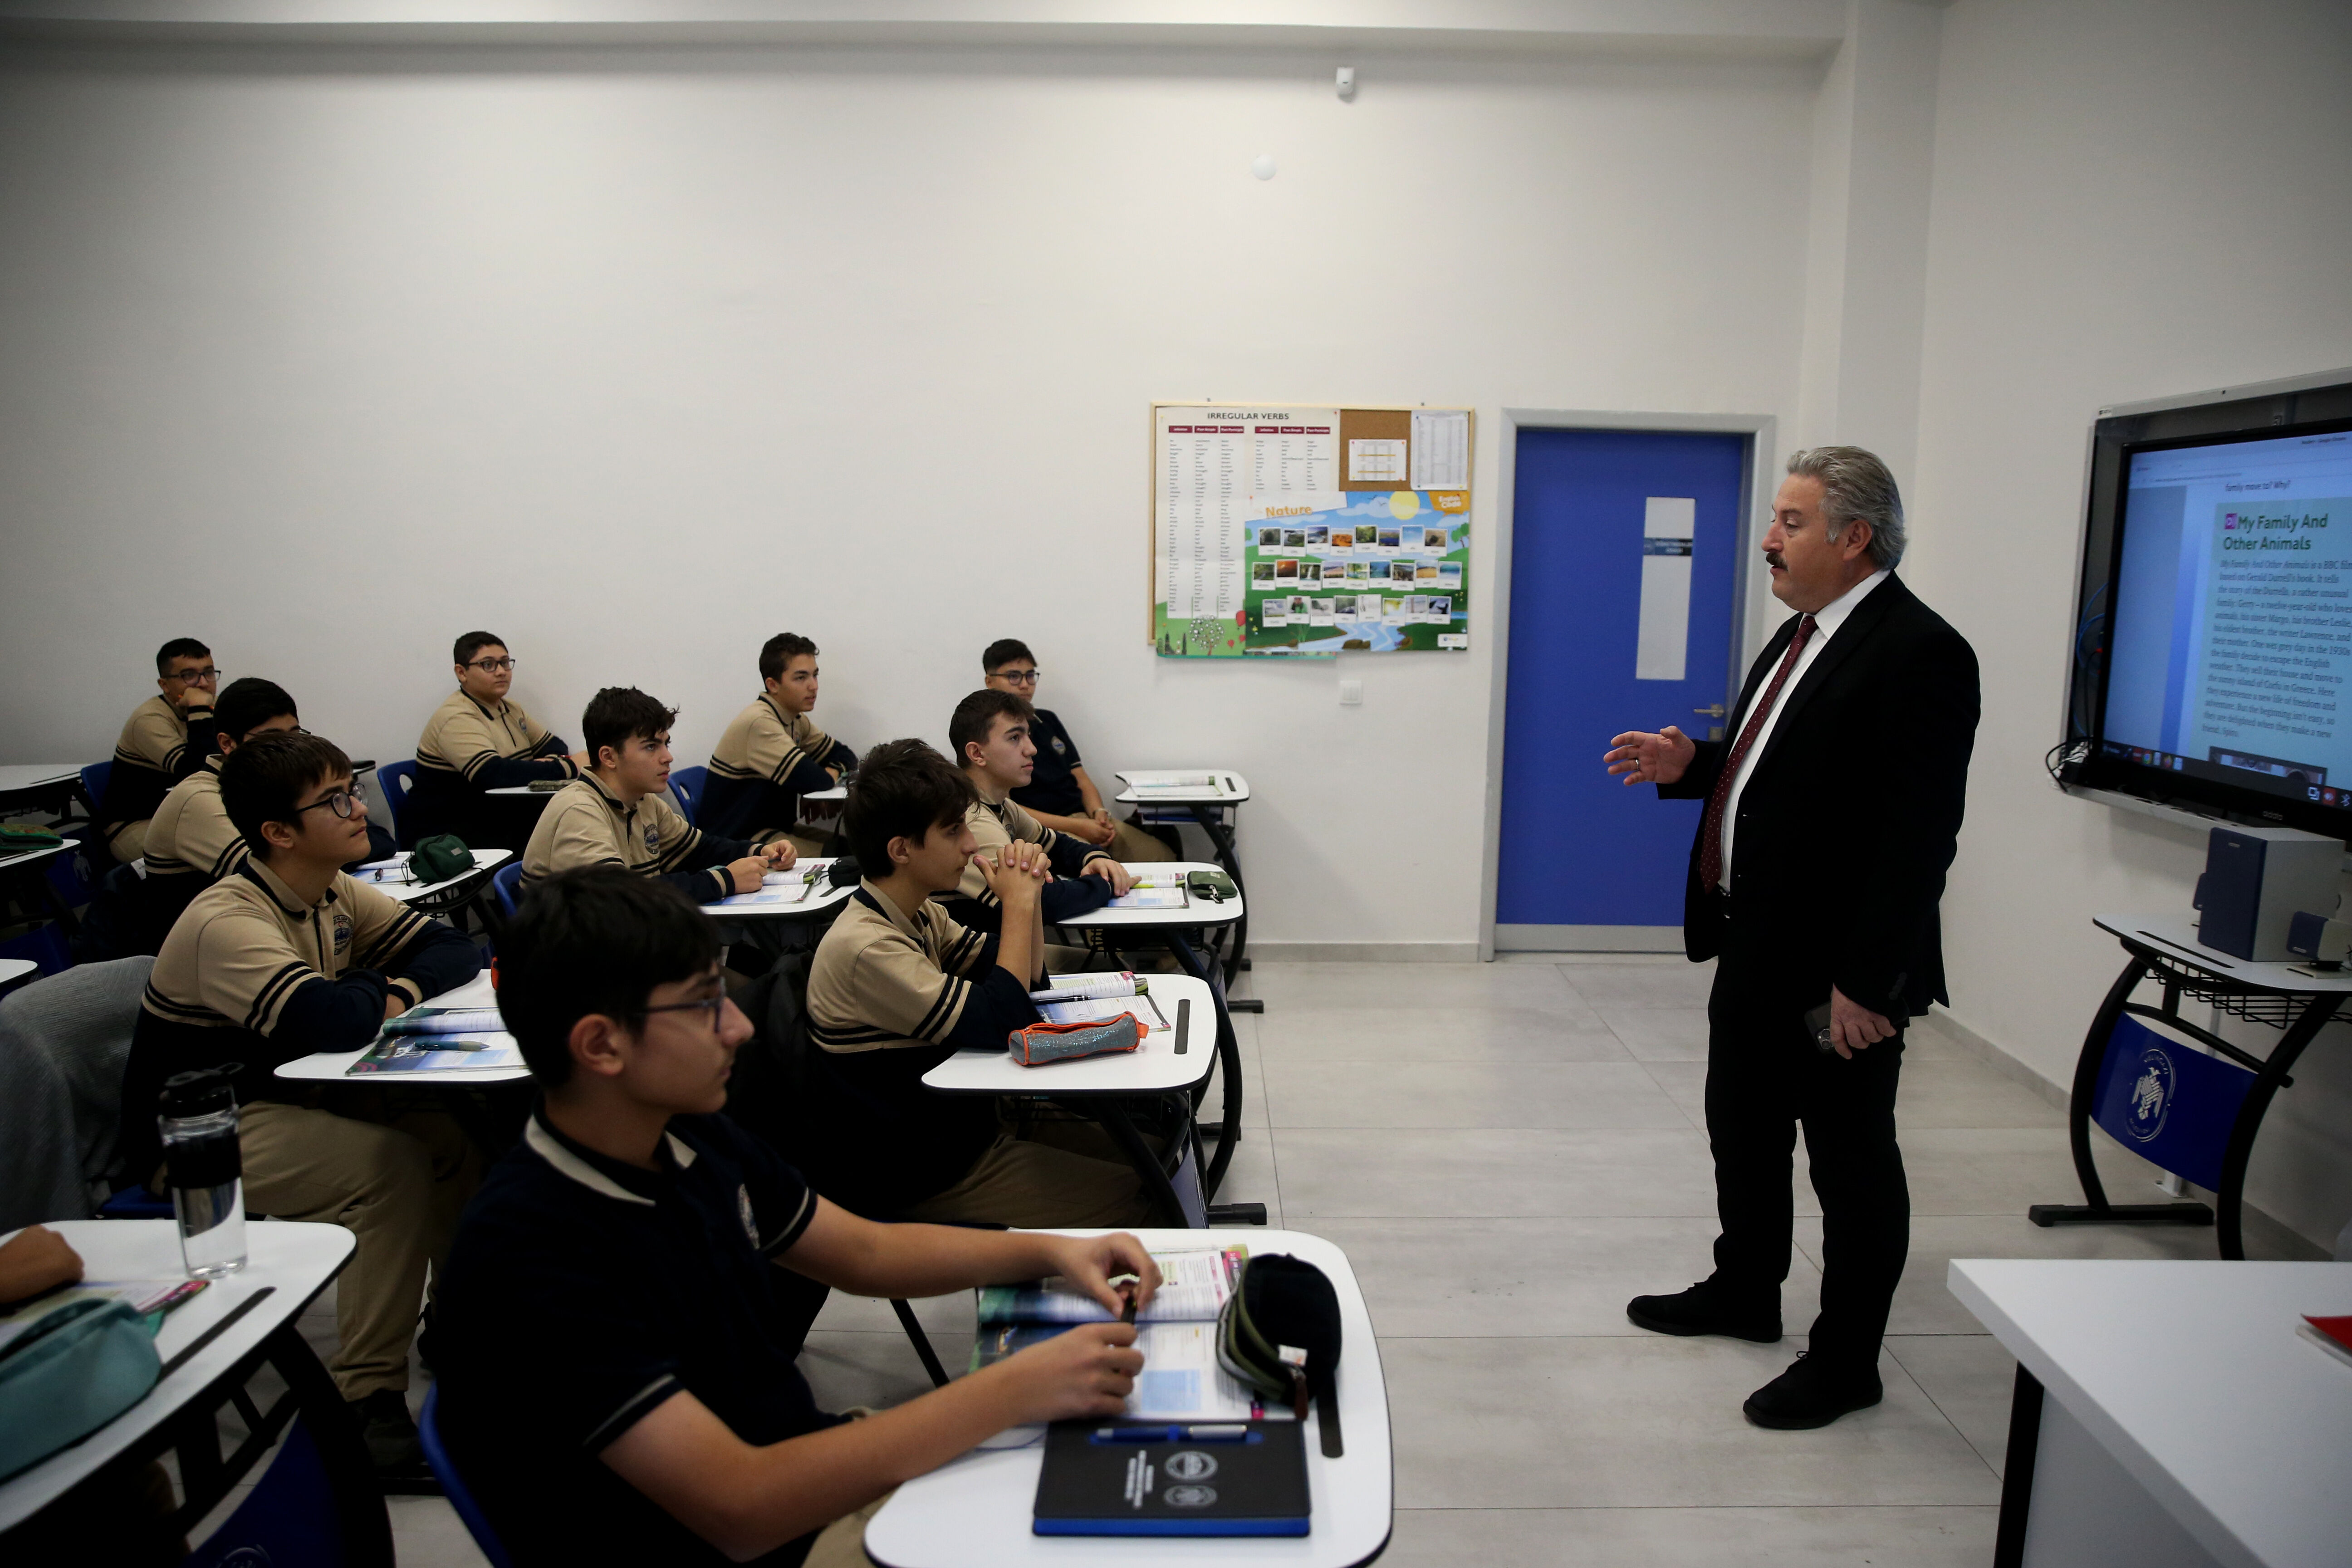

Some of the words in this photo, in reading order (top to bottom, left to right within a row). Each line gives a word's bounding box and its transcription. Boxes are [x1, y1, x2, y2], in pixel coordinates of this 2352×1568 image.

[2225, 483, 2243, 492] family
[2274, 480, 2291, 490] Why?
[1266, 505, 1312, 517] Nature
[2237, 516, 2255, 534] My
[2257, 514, 2299, 533] Family
[2301, 513, 2328, 529] And
[2224, 536, 2258, 550] Other
[2260, 535, 2311, 550] Animals
[2323, 561, 2339, 569] BBC
[2318, 686, 2335, 697] Here
